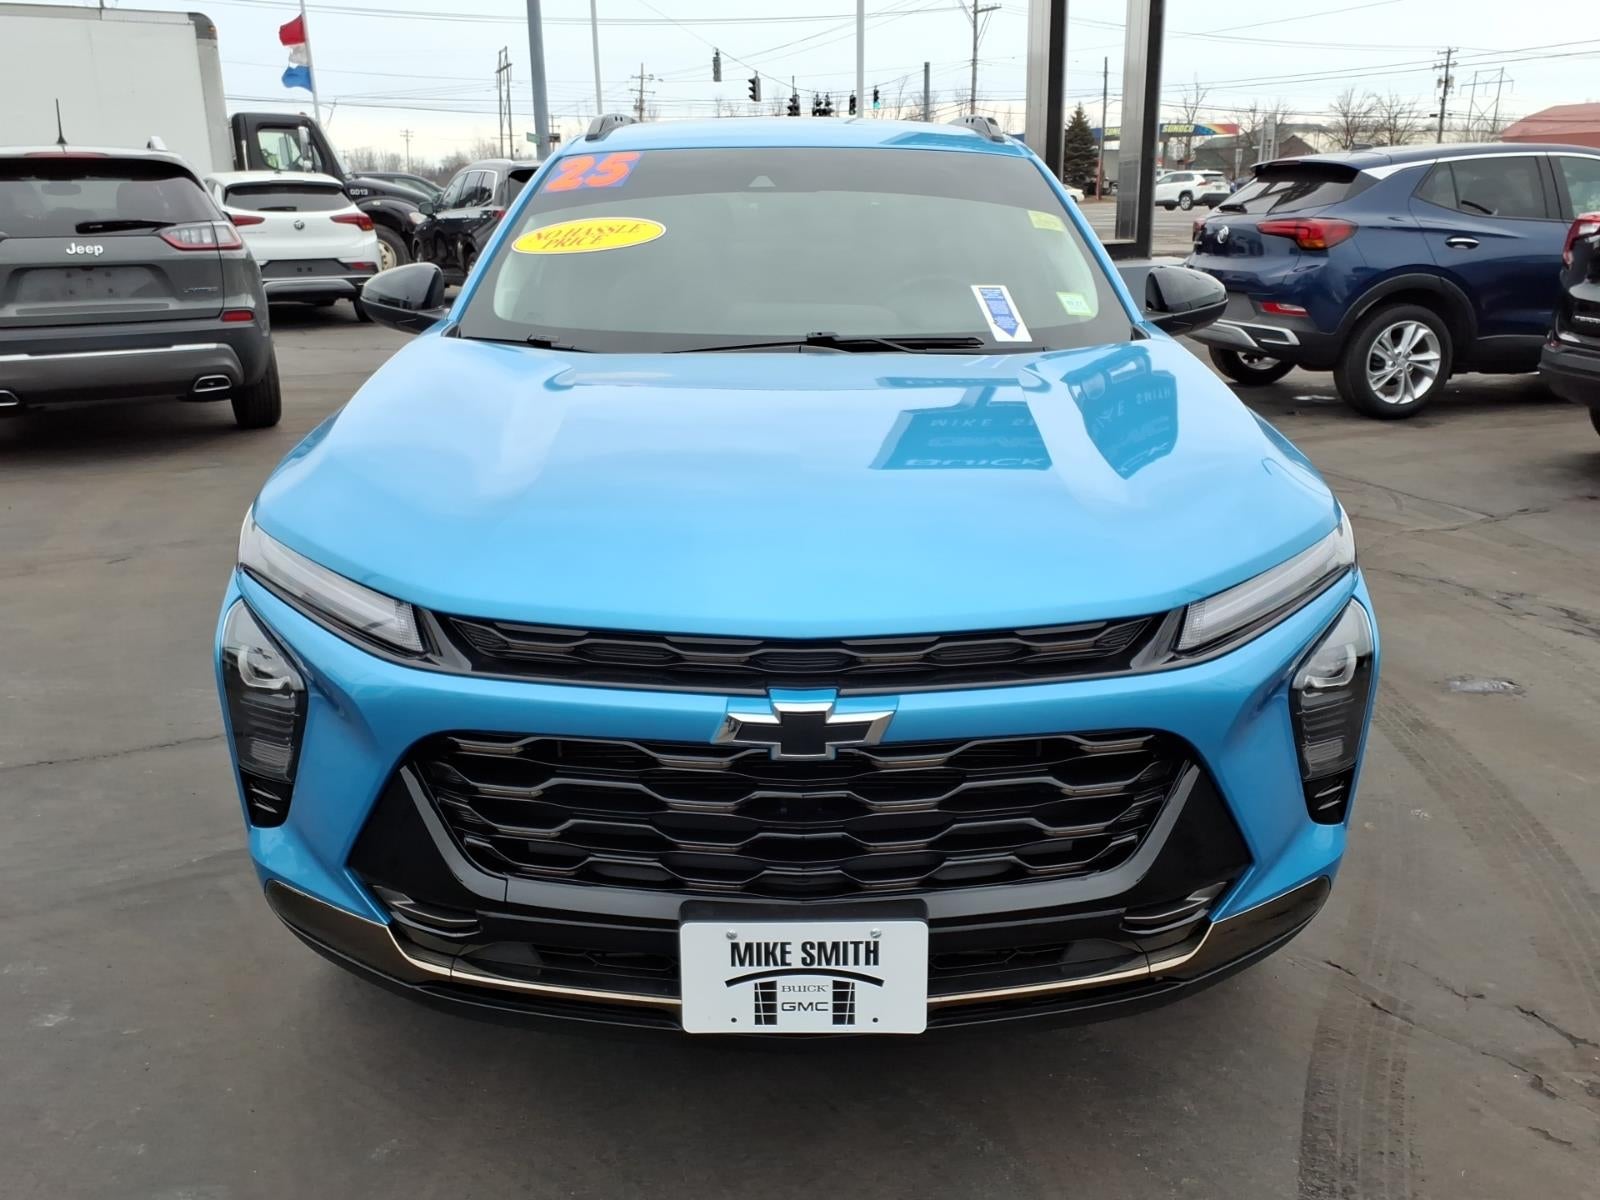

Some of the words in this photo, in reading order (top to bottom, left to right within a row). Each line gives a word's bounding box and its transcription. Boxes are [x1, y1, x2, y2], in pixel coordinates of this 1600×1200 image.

[1162, 124, 1195, 133] SUNOCO
[546, 152, 641, 192] 25
[532, 230, 563, 242] NO
[563, 223, 646, 238] HASSLE
[541, 235, 606, 249] PRICE
[66, 242, 104, 257] Jeep
[730, 941, 793, 967] MIKE
[801, 940, 880, 967] SMITH
[781, 984, 827, 993] BUICK
[781, 1001, 829, 1012] GMC
